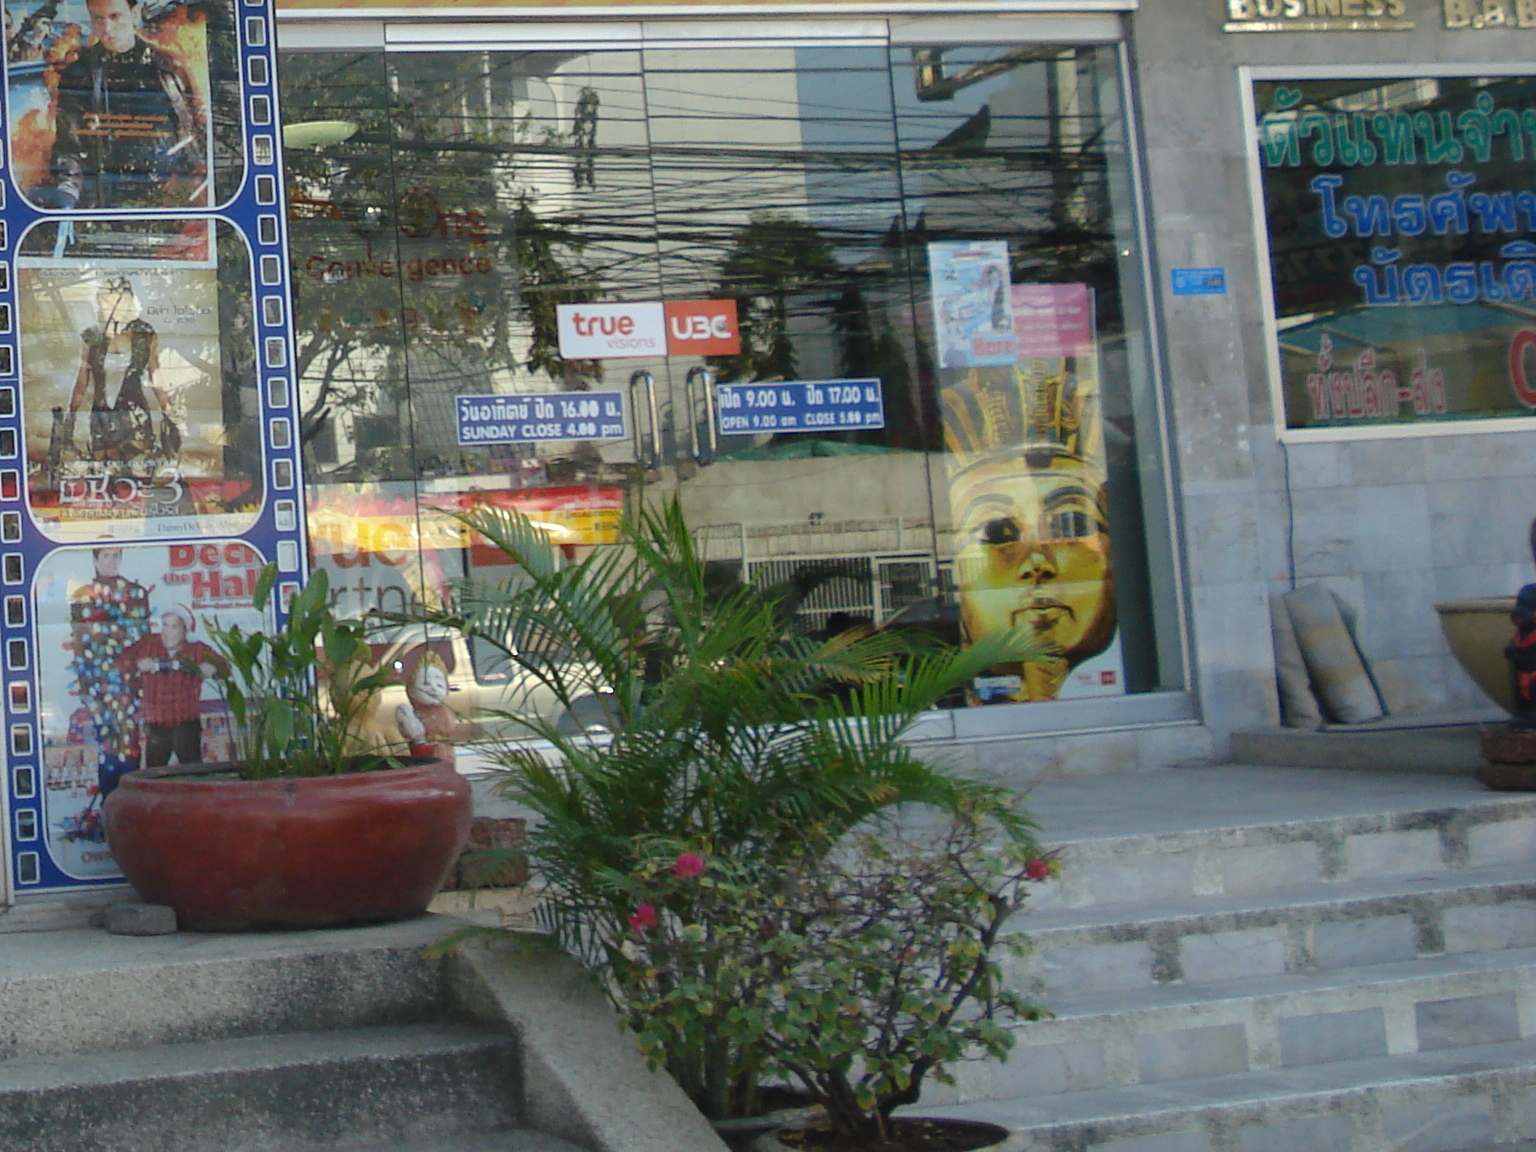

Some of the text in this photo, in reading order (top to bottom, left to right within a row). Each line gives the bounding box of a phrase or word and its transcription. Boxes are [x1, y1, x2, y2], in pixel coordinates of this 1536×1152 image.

[572, 311, 732, 340] true UBC
[607, 337, 657, 349] visions
[745, 390, 777, 408] 9.00
[560, 400, 600, 419] 16.00
[722, 415, 750, 429] OPEN
[753, 414, 777, 428] 9.00
[805, 412, 836, 426] CLOSE
[866, 412, 881, 425] pm
[462, 423, 622, 440] SUNDAY CLOSE 4.00 pm
[157, 466, 184, 505] 3
[192, 569, 261, 599] Hal
